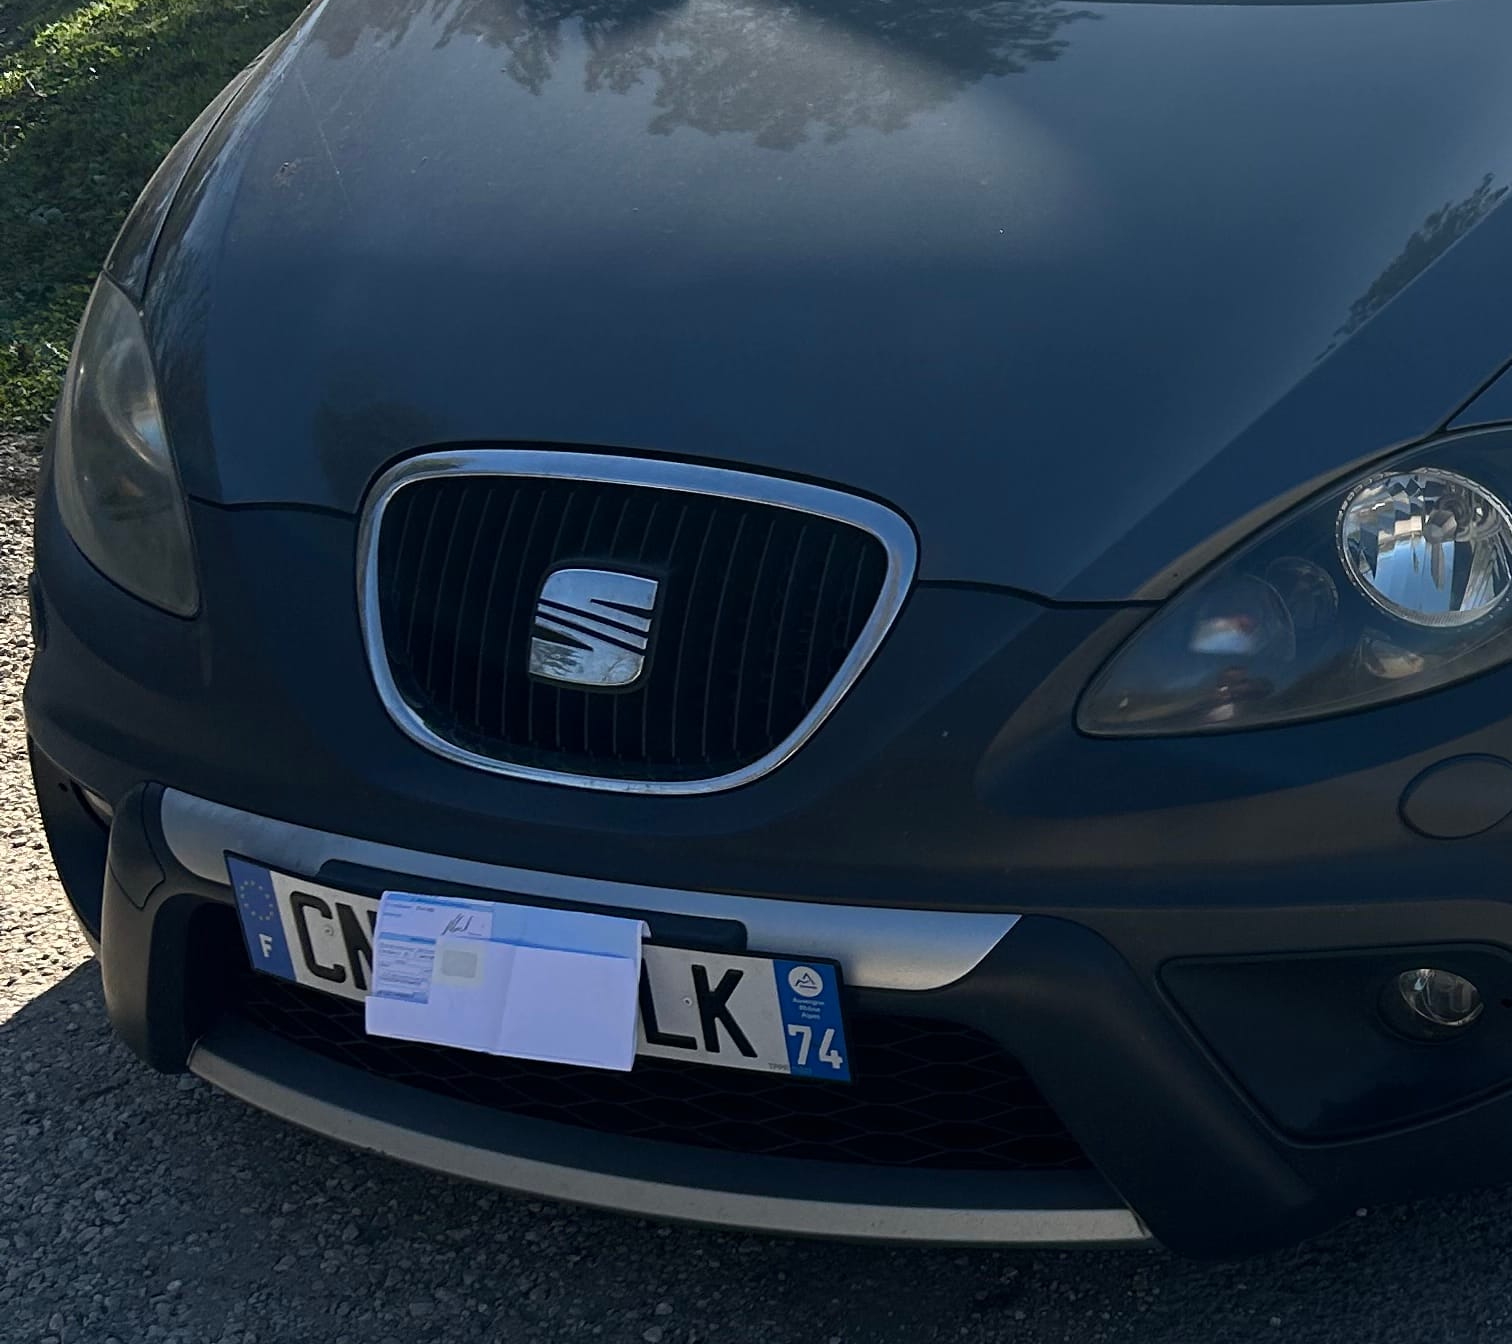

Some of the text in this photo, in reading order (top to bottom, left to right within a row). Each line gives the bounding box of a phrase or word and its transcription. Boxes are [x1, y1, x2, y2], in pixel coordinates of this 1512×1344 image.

[258, 933, 273, 958] F
[638, 956, 758, 1058] LK
[787, 1023, 844, 1070] 74
